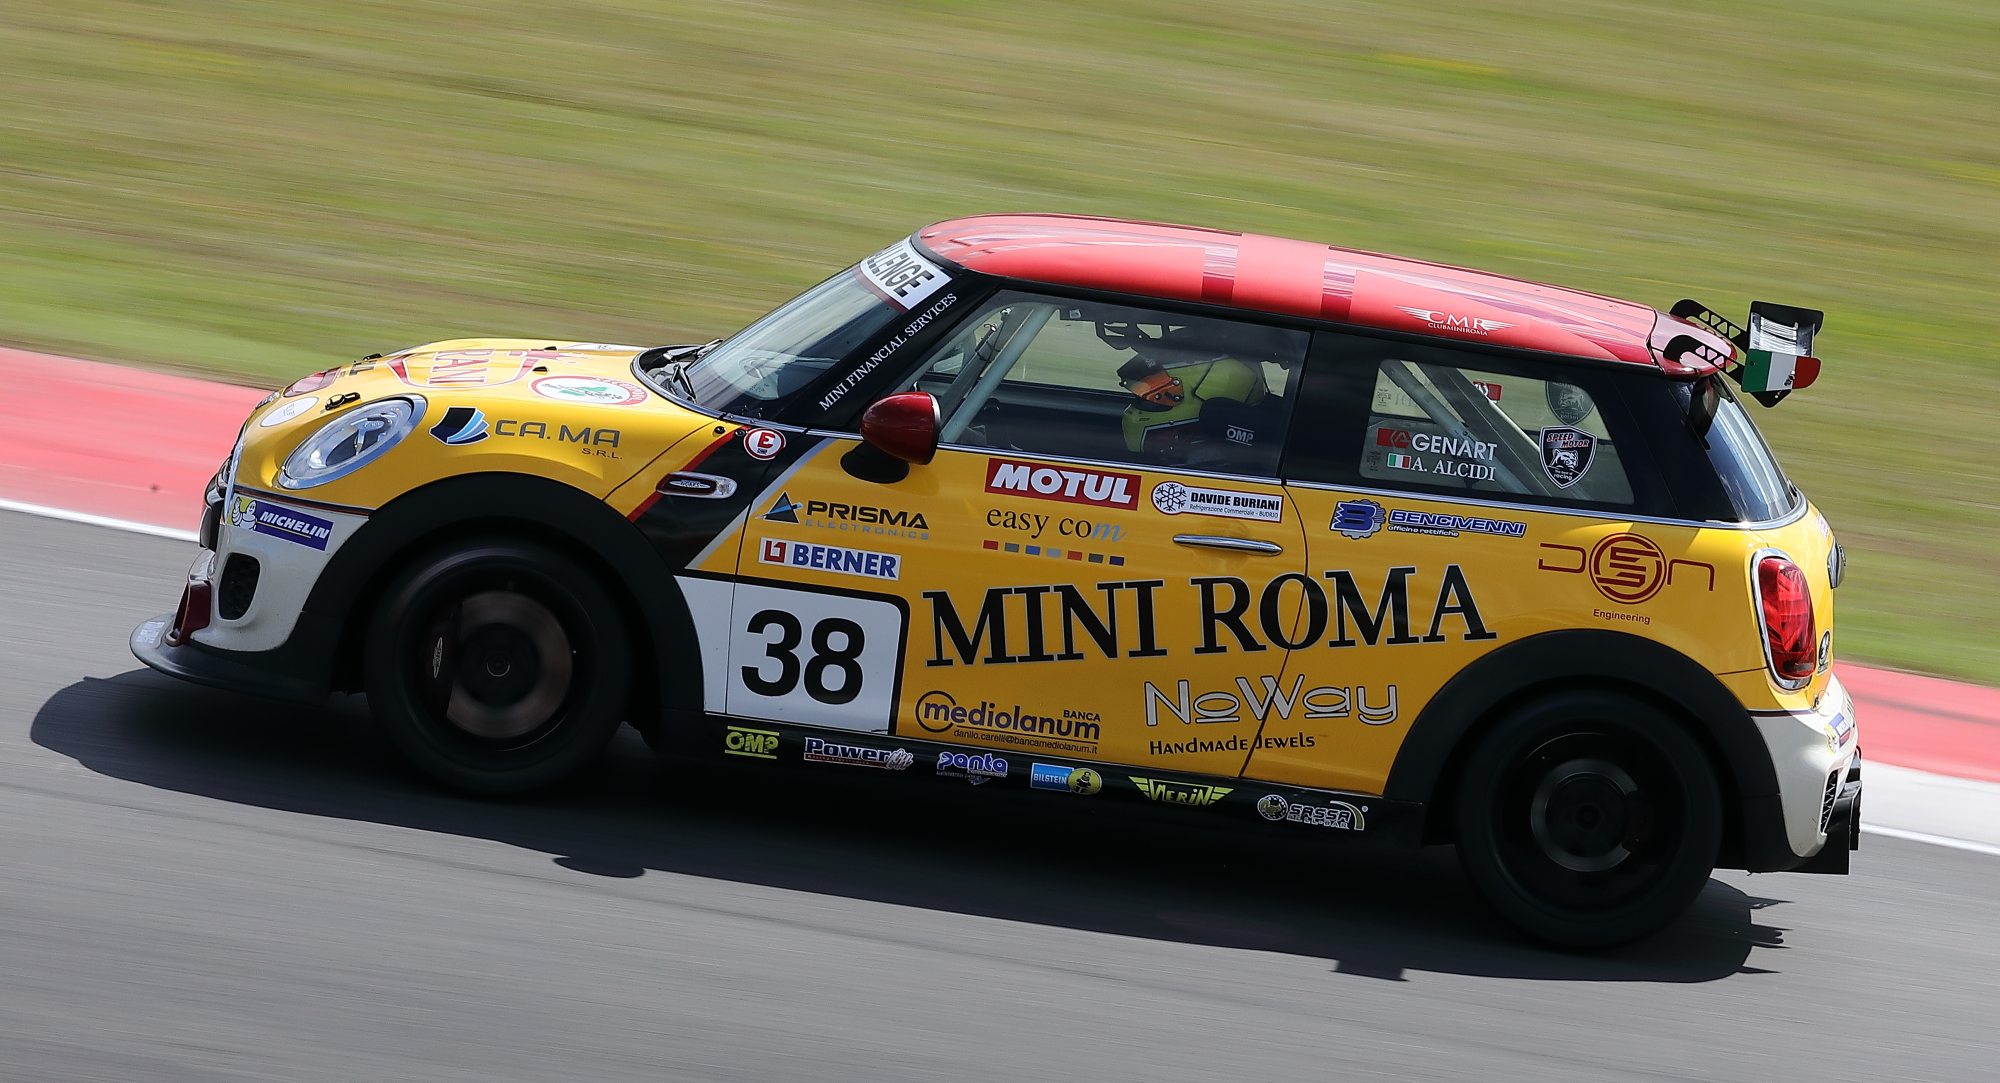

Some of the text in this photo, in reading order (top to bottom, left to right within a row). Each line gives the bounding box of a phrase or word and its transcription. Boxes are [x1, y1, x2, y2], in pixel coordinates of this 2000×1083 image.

[1427, 311, 1490, 332] CMR
[1427, 322, 1488, 336] CLUBMINIROMA
[819, 293, 957, 411] MINI FINANCIAL SERVICES
[757, 432, 775, 448] E
[1226, 427, 1254, 444] OMP
[1547, 433, 1574, 443] SPEED
[1561, 440, 1589, 449] MOTOR
[582, 448, 623, 459] S.R.L.
[1411, 433, 1498, 461] GENART
[1411, 457, 1496, 481] A. ALCIDI
[1553, 473, 1573, 481] racing
[990, 463, 1132, 504] MOTUL
[1189, 504, 1224, 513] Refrigerazione
[1224, 507, 1255, 516] Commerciale
[1190, 492, 1280, 511] DAVIDE BURIANI
[259, 511, 330, 539] MICHELIN
[806, 500, 930, 530] PRISMA
[986, 509, 1129, 542] easy com
[1390, 510, 1526, 535] BENCIVENNI
[805, 519, 930, 541] ELECTRONICS
[1388, 525, 1459, 537] officine rettifiche
[792, 543, 897, 579] BERNER
[921, 564, 1498, 667] MINI ROMA
[1593, 608, 1651, 625] Engineering
[741, 609, 866, 705] 38
[1144, 674, 1398, 726] NoWay
[916, 690, 1101, 741] mediolanum
[1063, 709, 1101, 722] BANCA
[726, 731, 779, 754] OMP
[937, 752, 1009, 774] panta
[1033, 773, 1067, 785] BILSTEIN
[1290, 804, 1351, 822] SASSA
